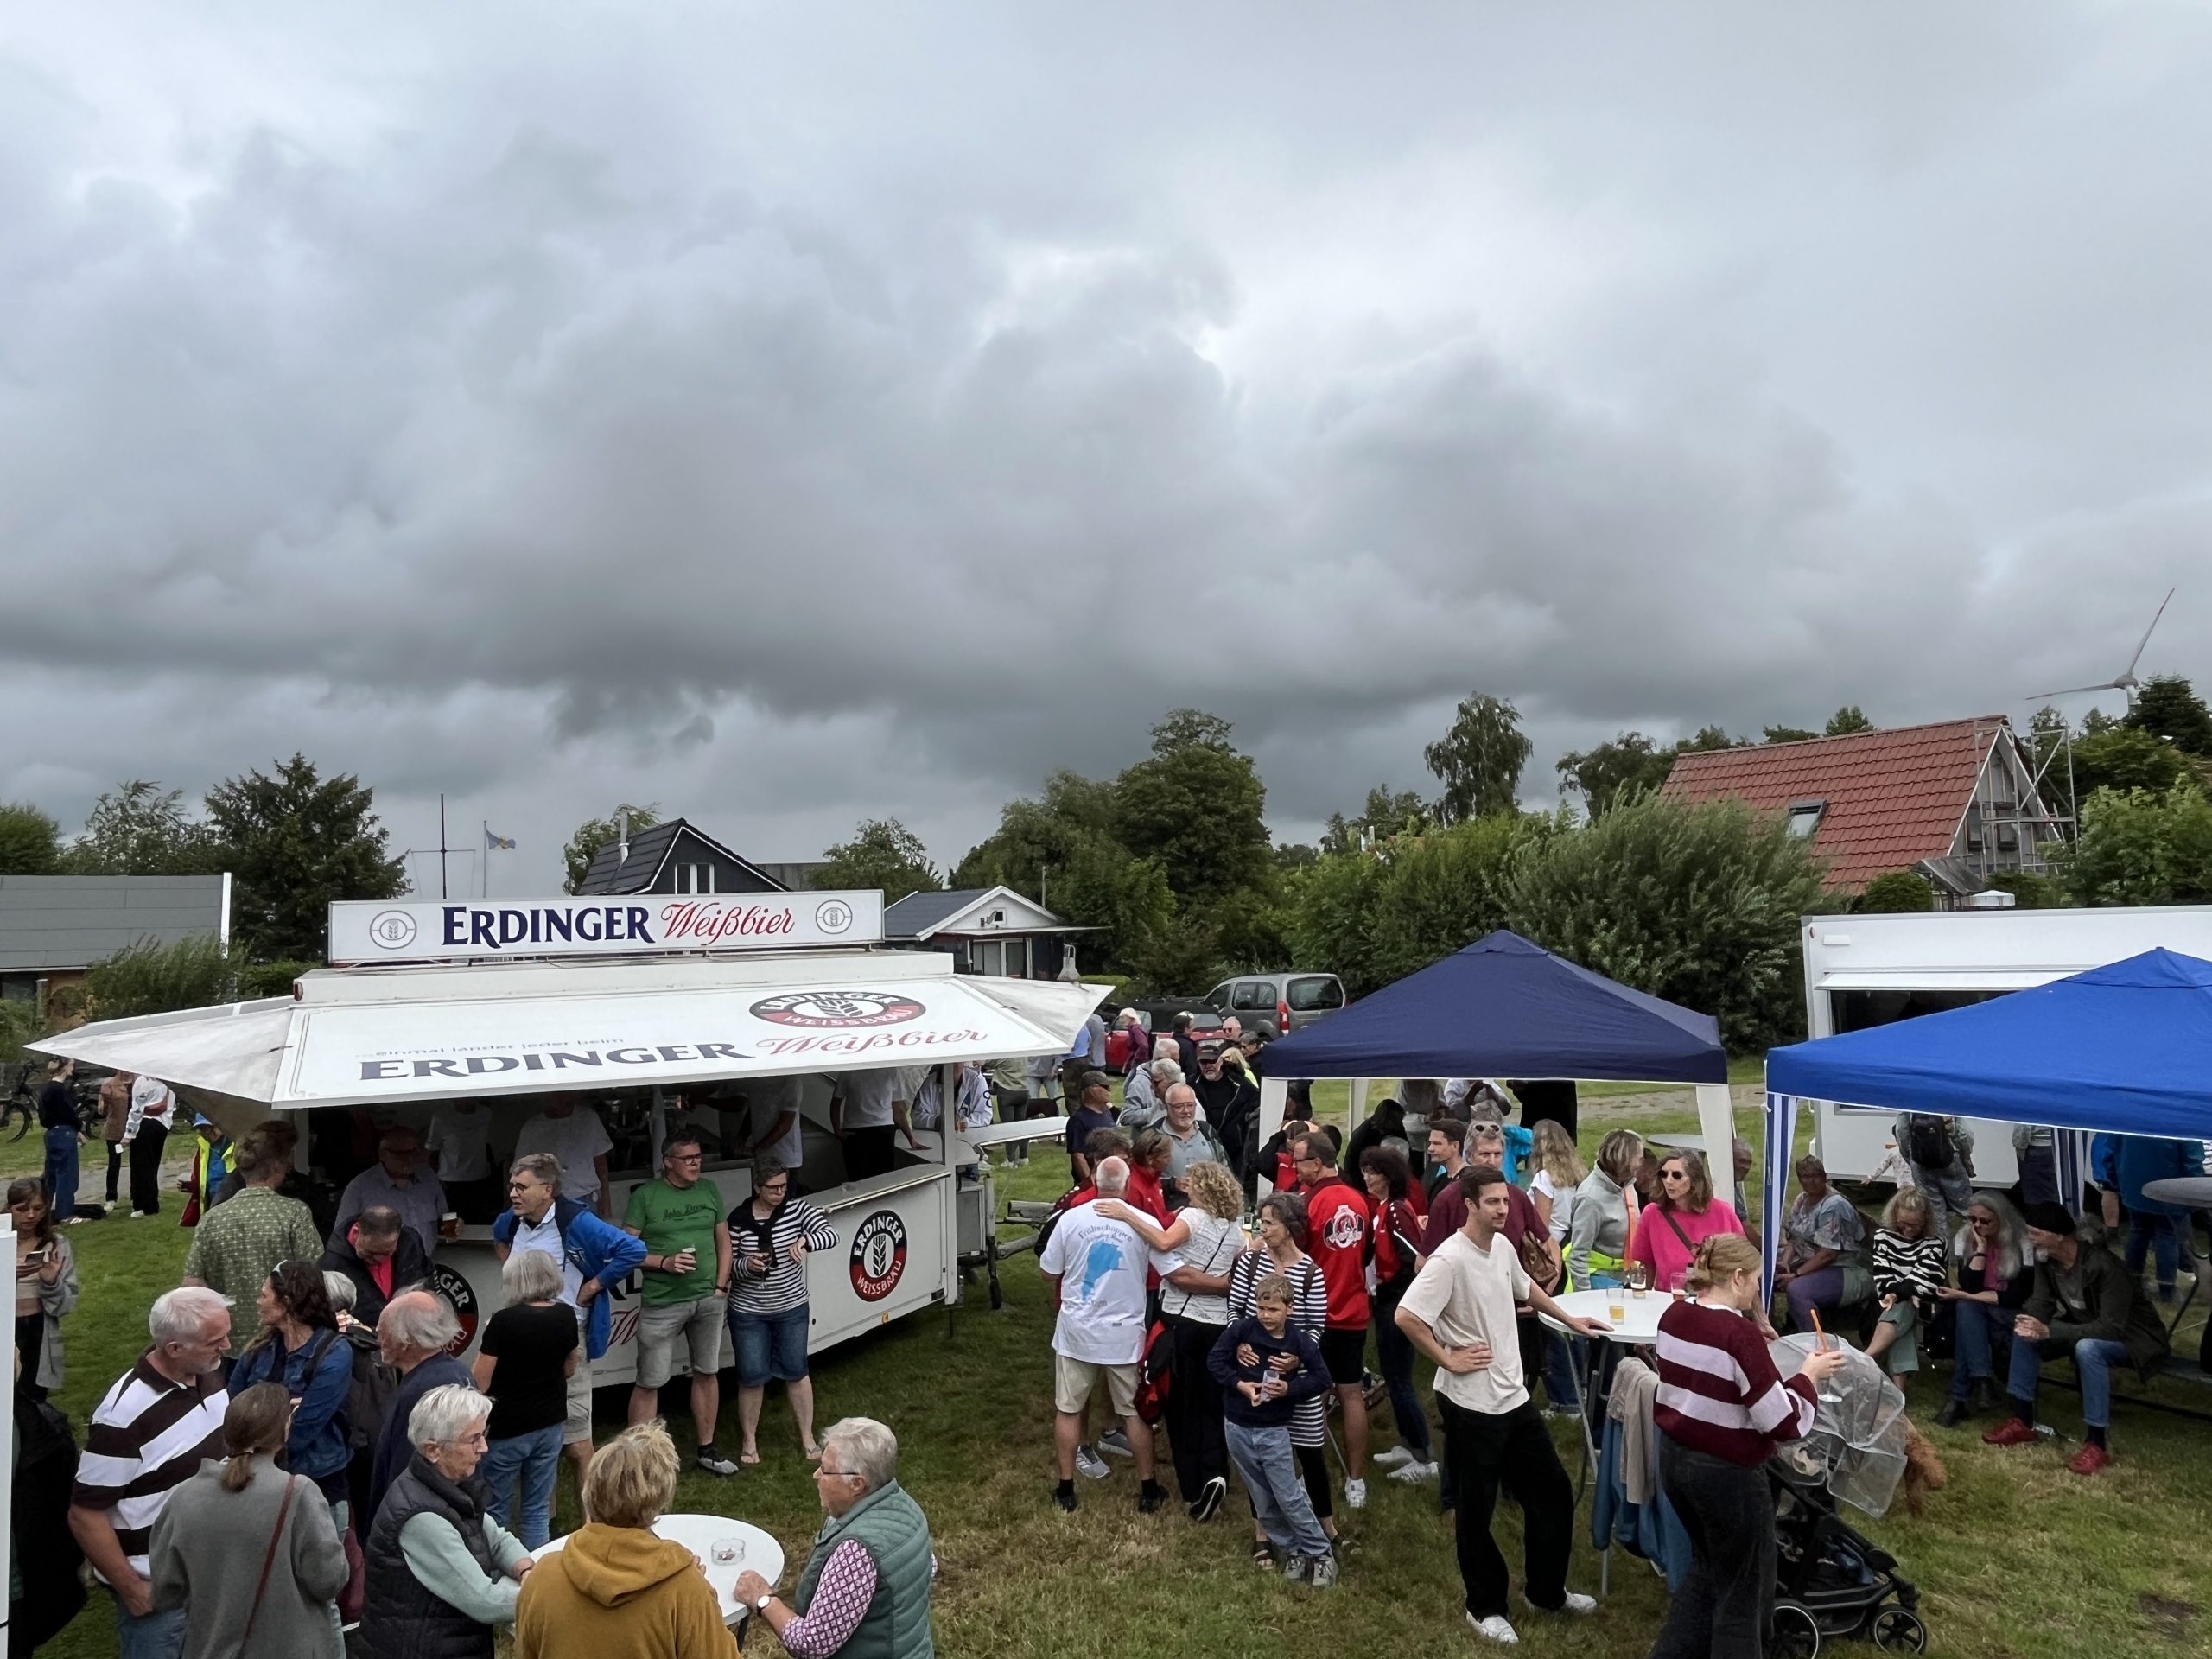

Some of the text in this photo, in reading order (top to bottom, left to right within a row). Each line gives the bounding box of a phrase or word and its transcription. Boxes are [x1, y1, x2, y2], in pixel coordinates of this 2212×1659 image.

[442, 901, 795, 949] ERDINGER Weißbier
[359, 1029, 988, 1080] ERDINGER Weißbier
[854, 1215, 903, 1256] ERDINGER
